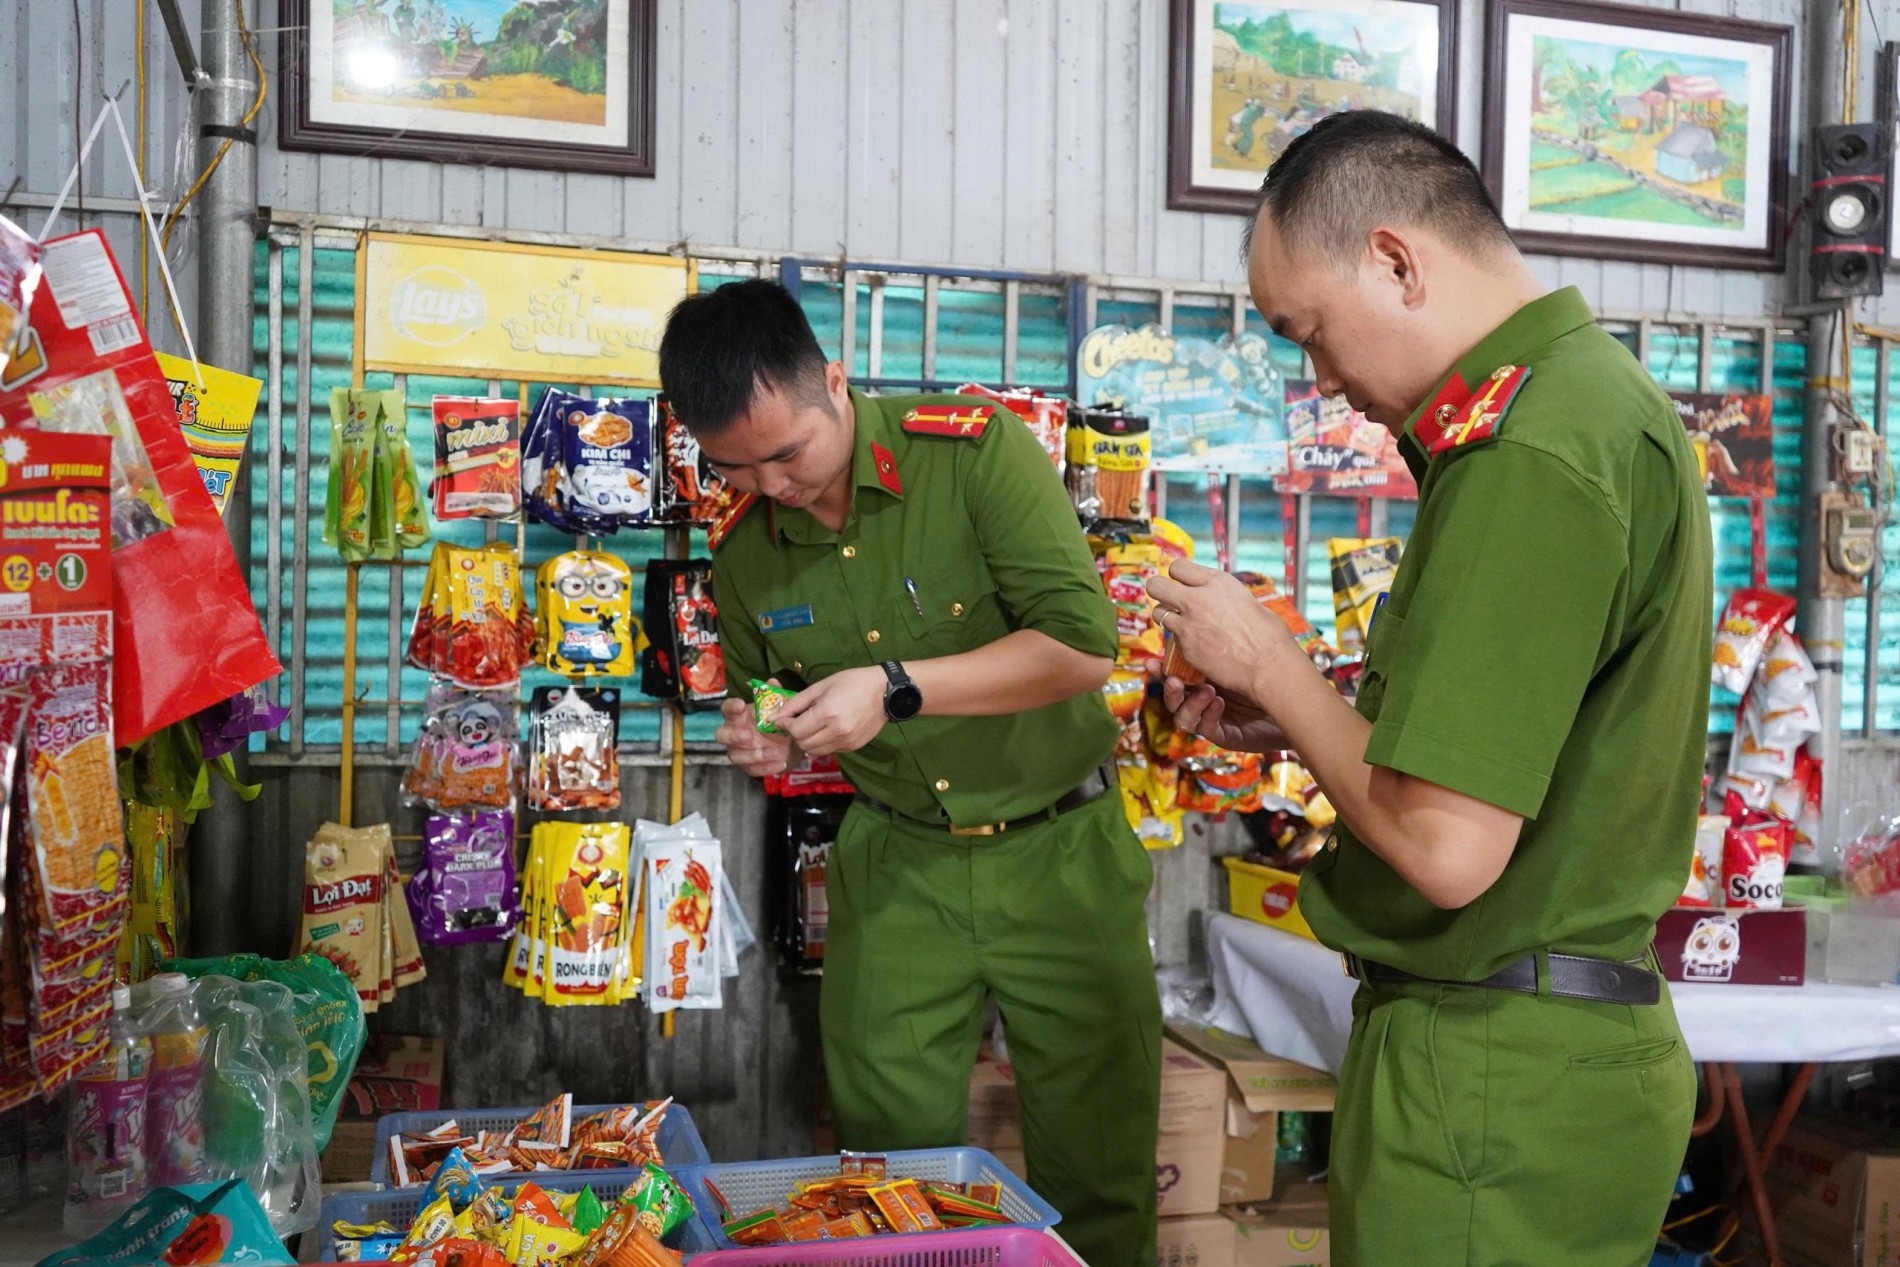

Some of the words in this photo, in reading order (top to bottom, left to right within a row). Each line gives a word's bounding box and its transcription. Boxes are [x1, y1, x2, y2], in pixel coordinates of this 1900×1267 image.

[1083, 326, 1177, 379] Cheetos
[581, 447, 608, 459] KIM
[609, 447, 631, 460] CHI
[7, 563, 29, 581] 12
[62, 556, 77, 582] 1
[36, 716, 98, 748] Bento
[446, 862, 473, 873] DARK
[556, 962, 587, 978] RONG
[121, 1084, 144, 1095] KIRIN
